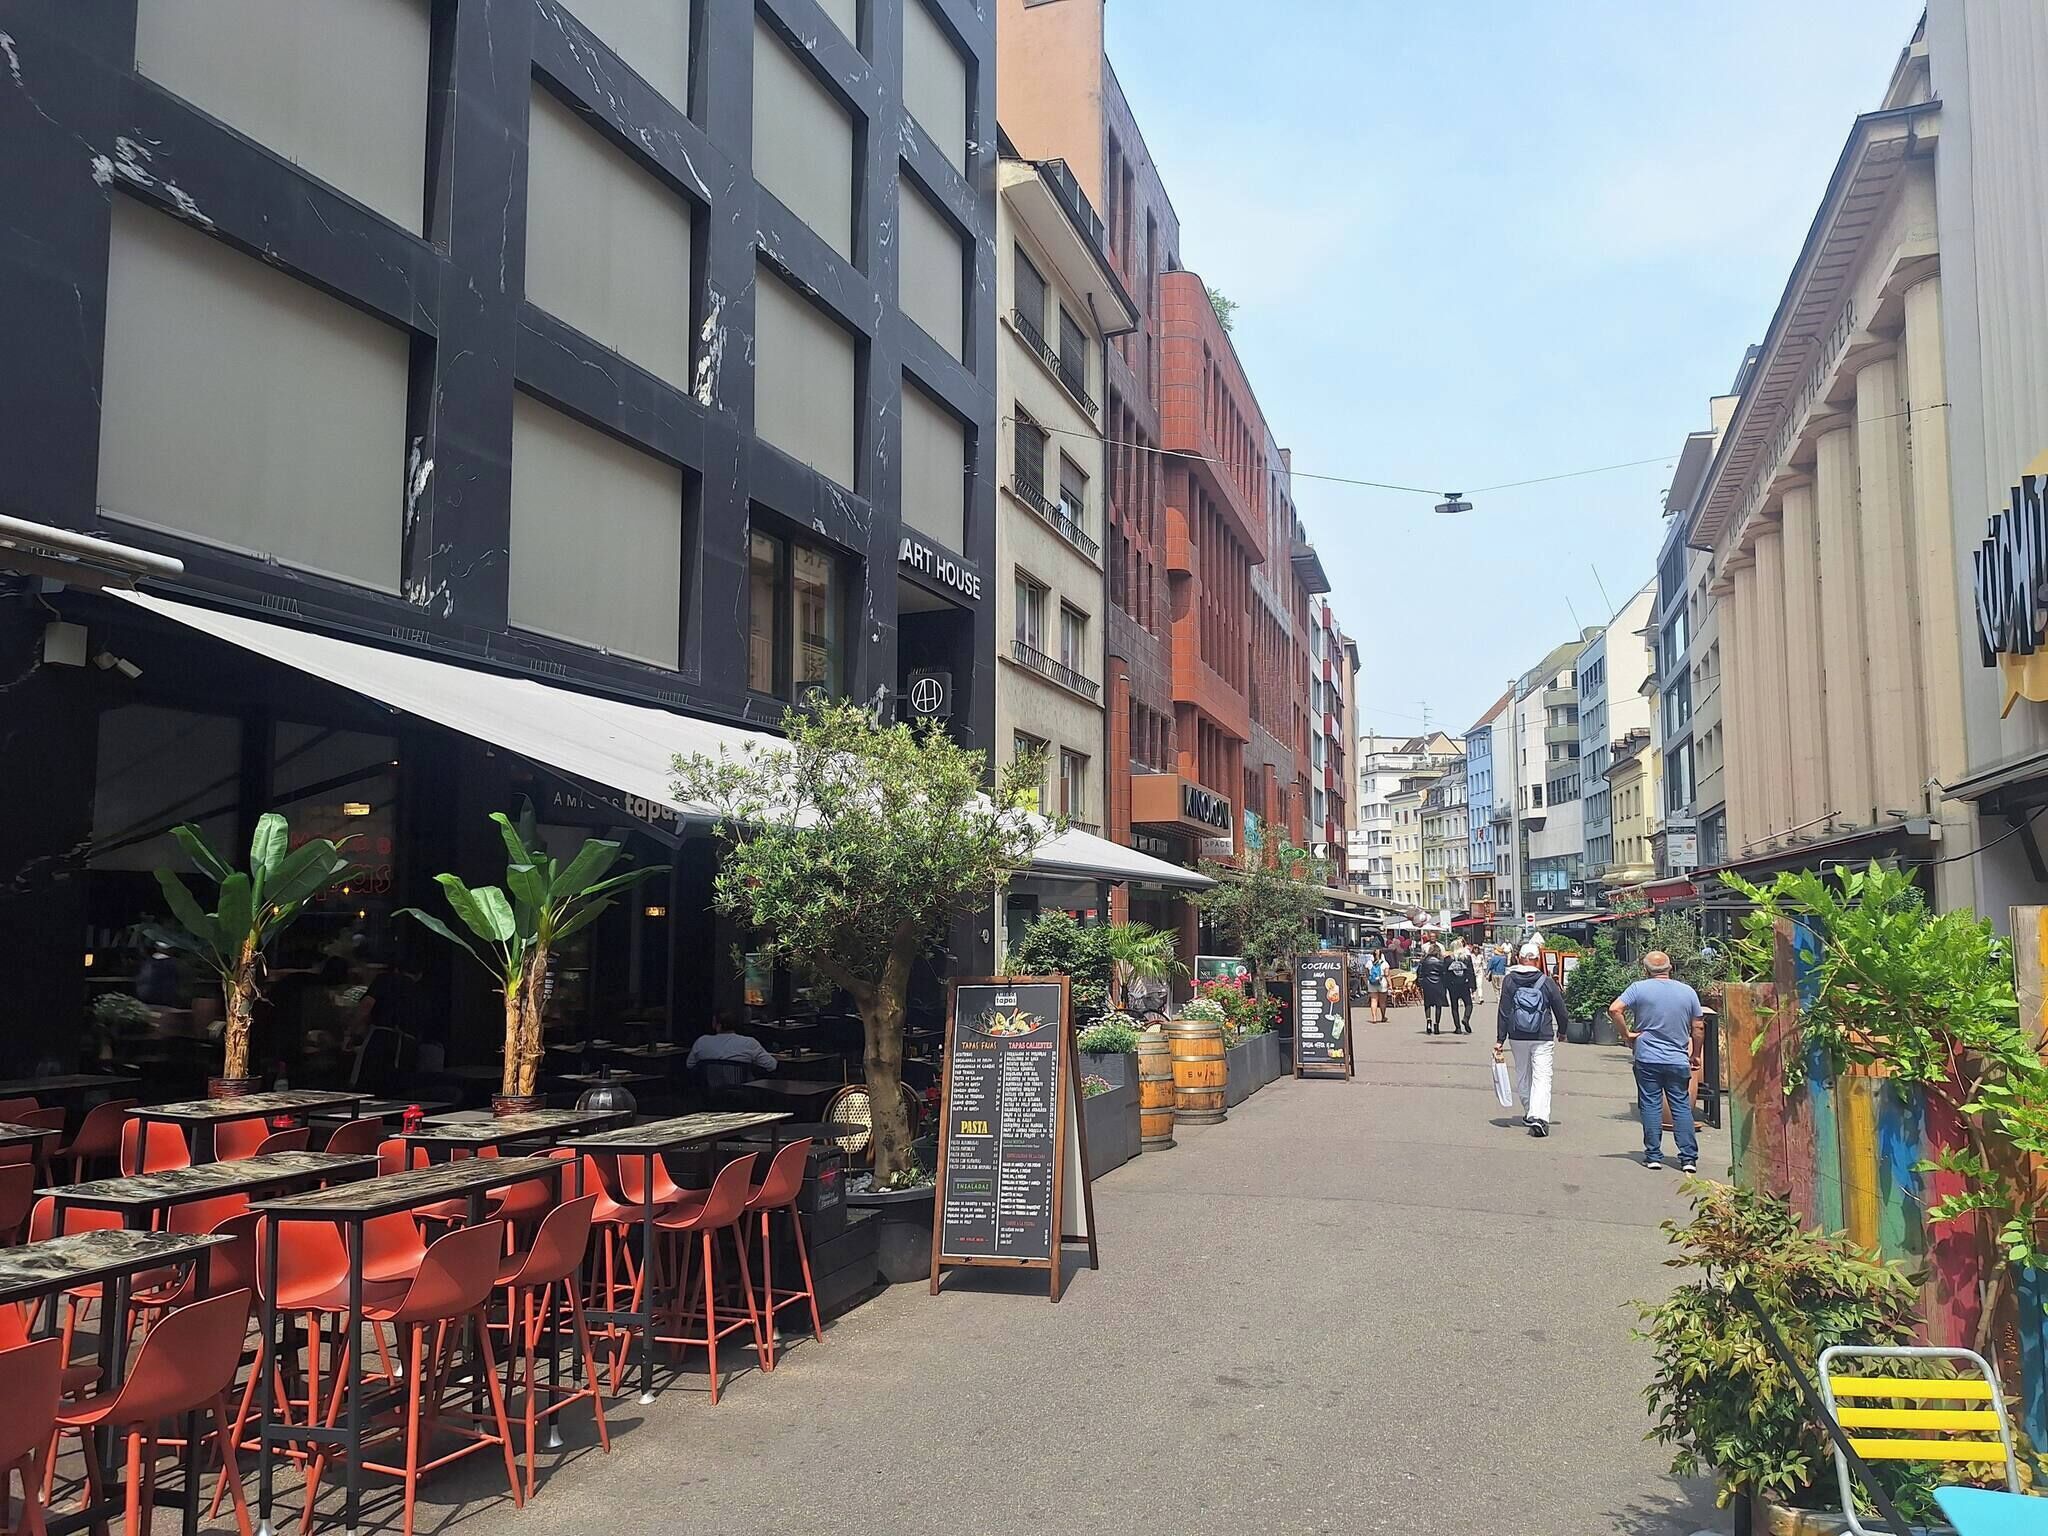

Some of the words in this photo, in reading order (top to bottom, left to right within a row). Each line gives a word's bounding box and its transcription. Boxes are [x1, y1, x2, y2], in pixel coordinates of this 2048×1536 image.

[899, 538, 932, 573] ART
[936, 555, 981, 600] HOUSE
[625, 792, 679, 823] tapa
[1301, 962, 1341, 970] COCTAILS
[1008, 1041, 1025, 1049] TAPAS
[960, 1120, 989, 1134] PASTA
